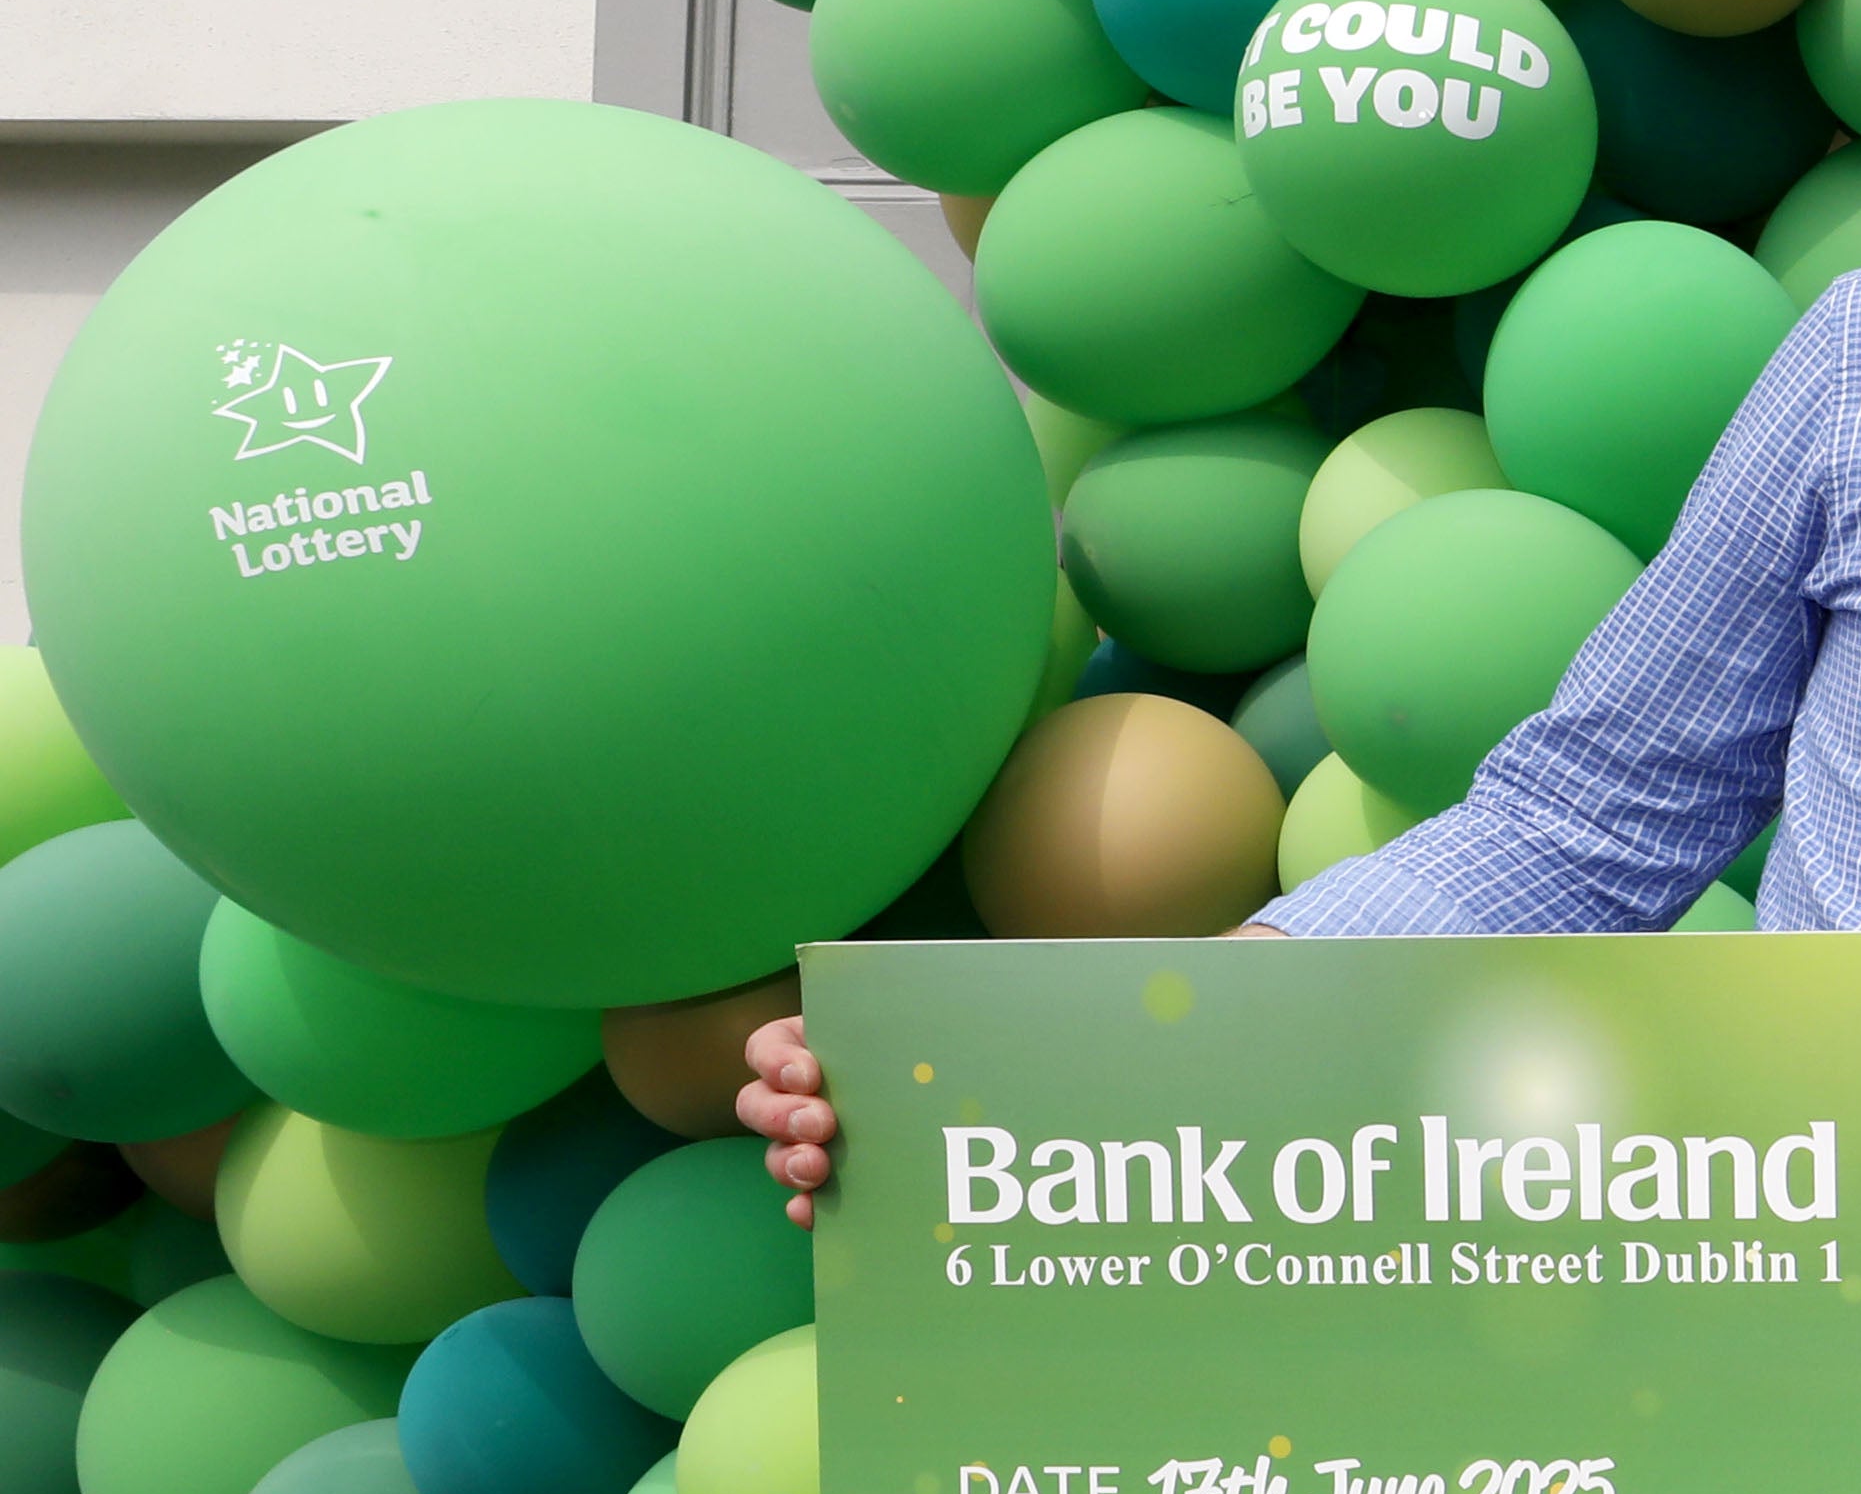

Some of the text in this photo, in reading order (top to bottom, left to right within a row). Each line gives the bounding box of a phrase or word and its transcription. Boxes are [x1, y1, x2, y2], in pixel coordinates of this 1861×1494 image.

[1280, 0, 1551, 90] COULD
[1242, 66, 1502, 141] BE YOU
[208, 469, 433, 541] National
[231, 518, 422, 578] Lottery
[941, 1115, 1838, 1225] Bank of Ireland
[945, 1243, 973, 1287] 6
[989, 1243, 1151, 1287] Lower
[1450, 1241, 1605, 1286] Street
[1619, 1239, 1800, 1285] Dublin
[1820, 1239, 1843, 1283] 1
